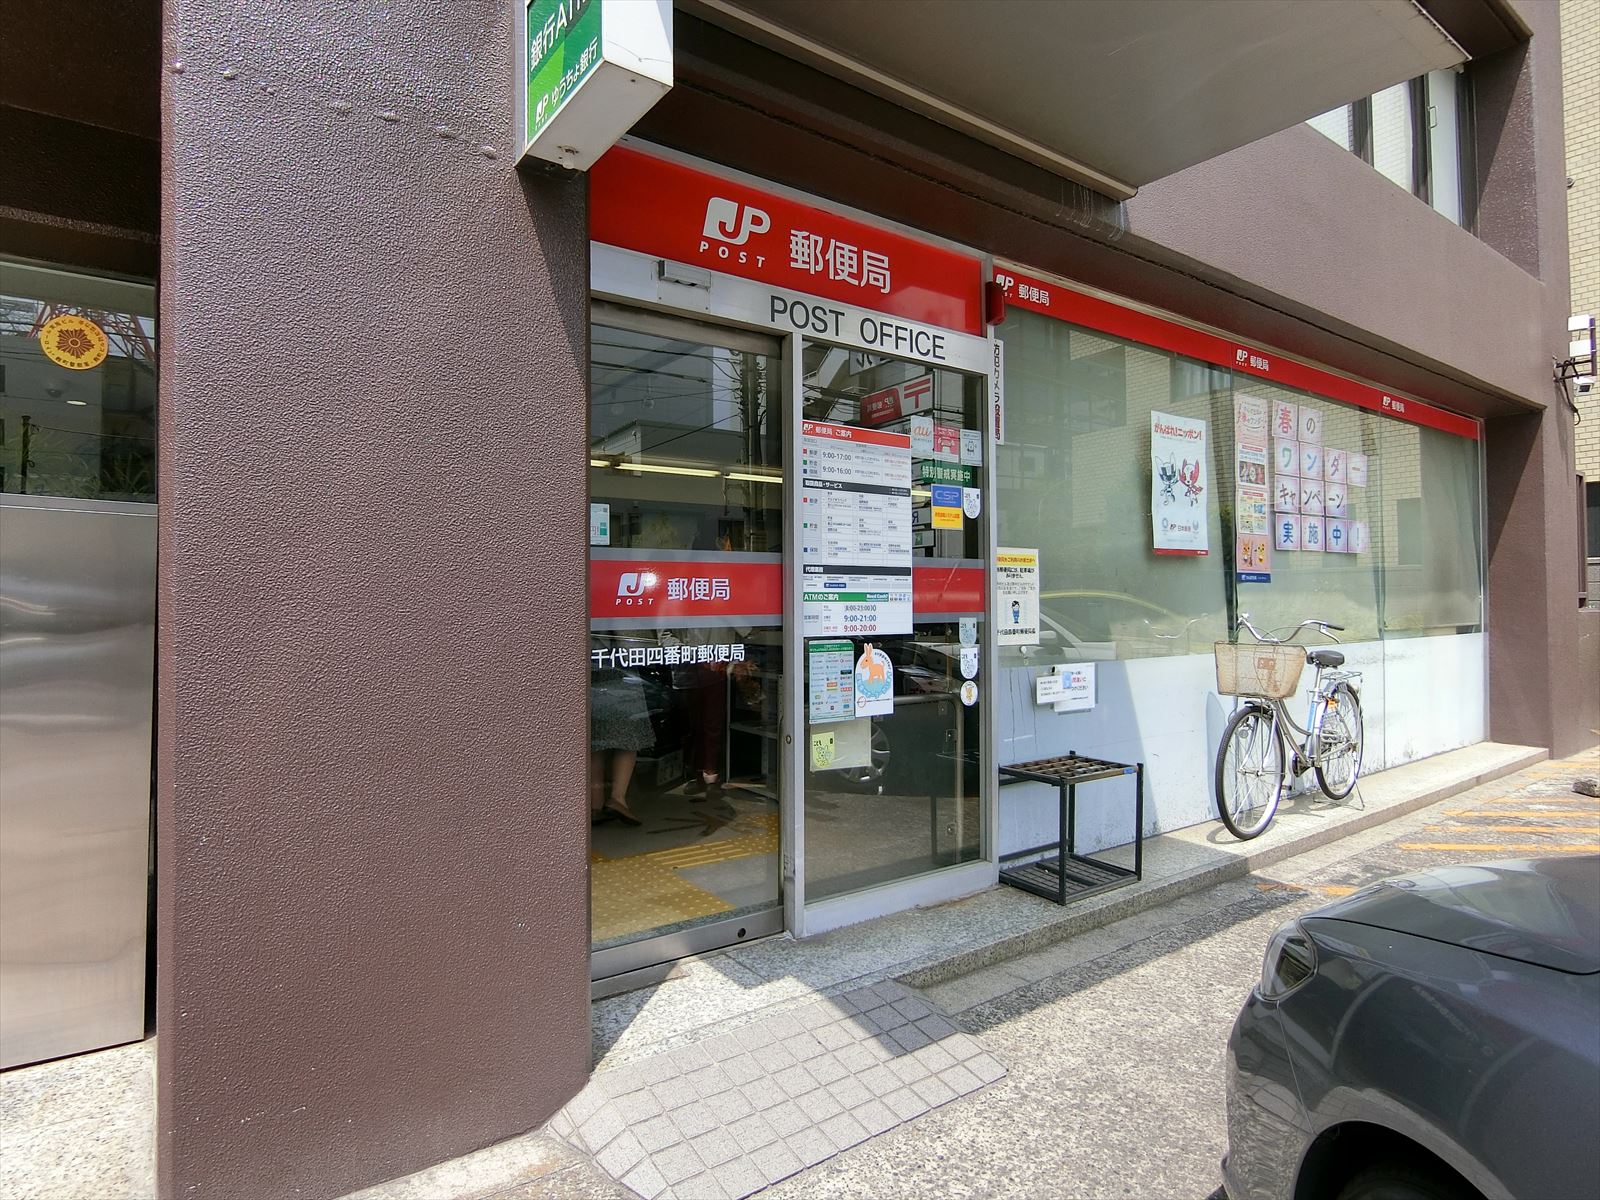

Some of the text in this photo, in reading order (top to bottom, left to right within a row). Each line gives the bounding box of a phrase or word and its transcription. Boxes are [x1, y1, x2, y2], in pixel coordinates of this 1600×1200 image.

[552, 36, 598, 107] ゆうちょ銀行
[700, 240, 766, 268] POST
[703, 197, 891, 294] JP 郵便局
[1018, 283, 1050, 306] 郵便局
[770, 295, 946, 361] POST OFFICE
[1250, 355, 1269, 371] 郵便局
[822, 451, 852, 461] 9:00-17:00
[1281, 446, 1361, 477] ワンダー
[822, 465, 852, 475] 9:00-16:00
[922, 465, 971, 482] 特別警戒実施中
[935, 490, 960, 500] CSP
[667, 577, 730, 601] 郵便局
[615, 598, 654, 606] POST
[843, 614, 877, 623] 9:00-21:00
[843, 624, 877, 633] 9:00-20:00
[591, 643, 745, 669] 千代田四番町郵便局
